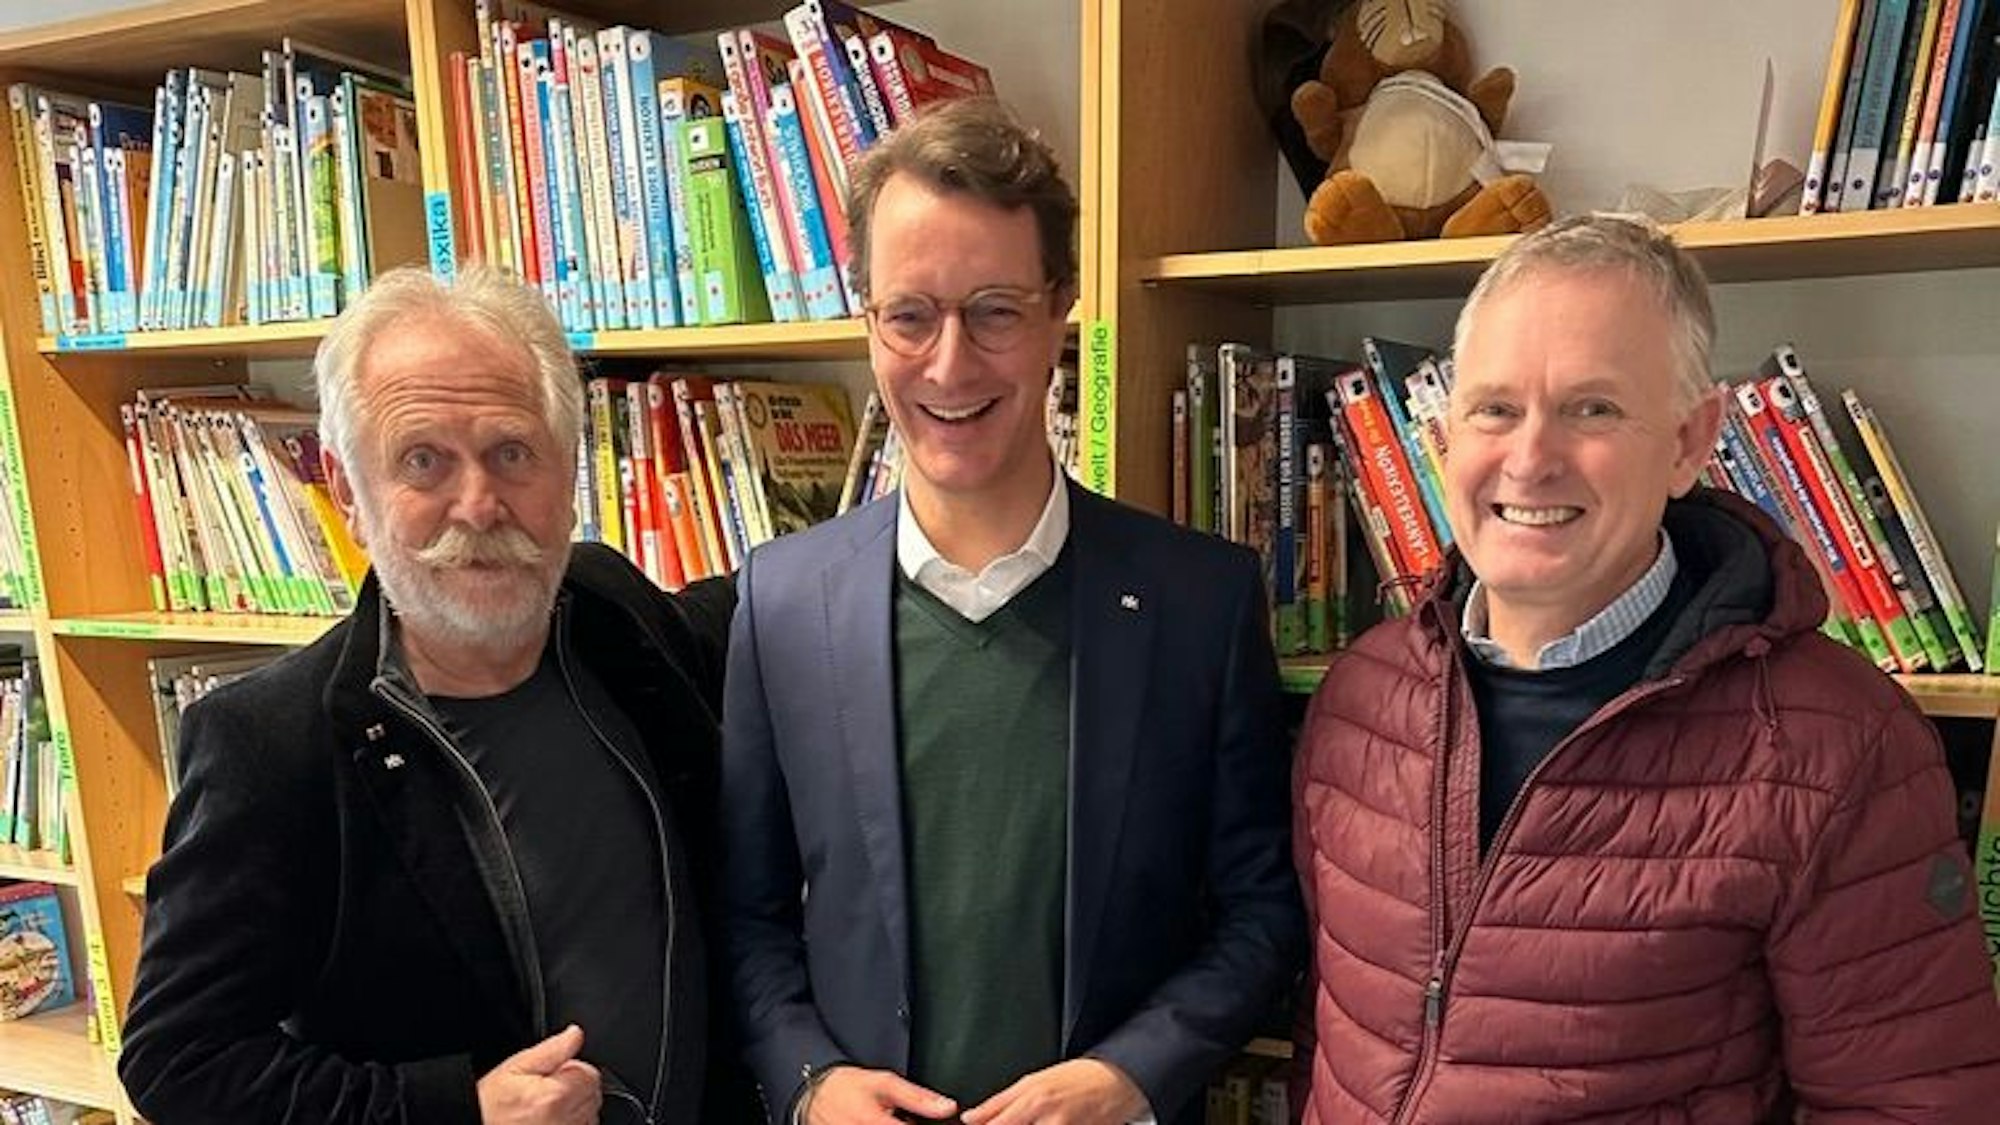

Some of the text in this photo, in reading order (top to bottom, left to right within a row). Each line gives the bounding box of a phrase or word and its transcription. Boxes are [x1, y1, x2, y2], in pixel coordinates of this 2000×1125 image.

[639, 95, 659, 219] KINDER LEXIKON
[431, 200, 453, 273] exika
[1090, 327, 1109, 432] Geografie
[1091, 454, 1105, 492] welt
[53, 730, 73, 780] Tiere
